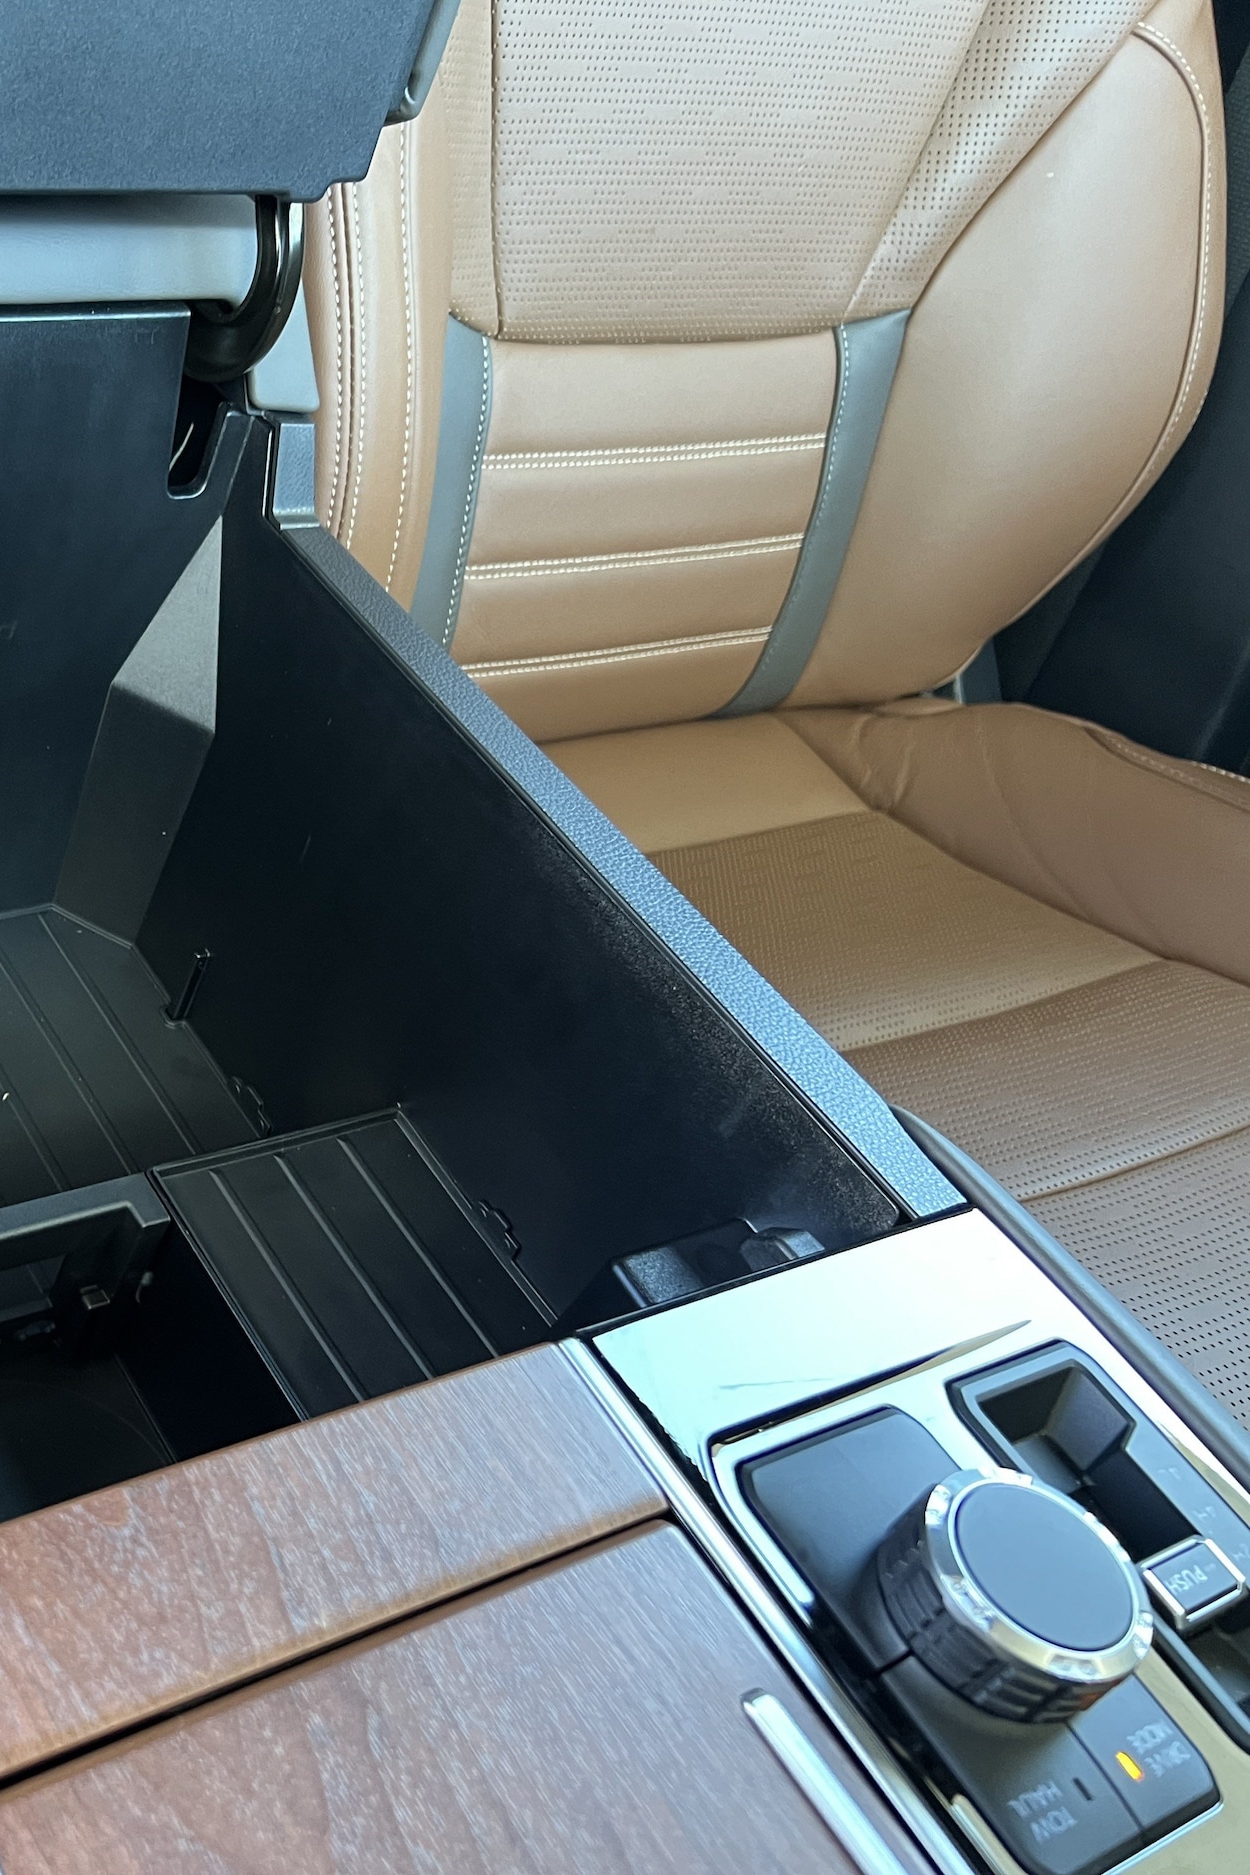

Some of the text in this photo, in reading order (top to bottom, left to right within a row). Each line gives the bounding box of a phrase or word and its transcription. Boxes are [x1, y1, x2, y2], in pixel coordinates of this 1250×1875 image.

[1164, 1565, 1208, 1595] PUSH
[1126, 1720, 1174, 1754] MODE
[1143, 1741, 1192, 1777] DRIVE
[1006, 1780, 1064, 1820] HAUL
[1029, 1806, 1078, 1844] TOW
